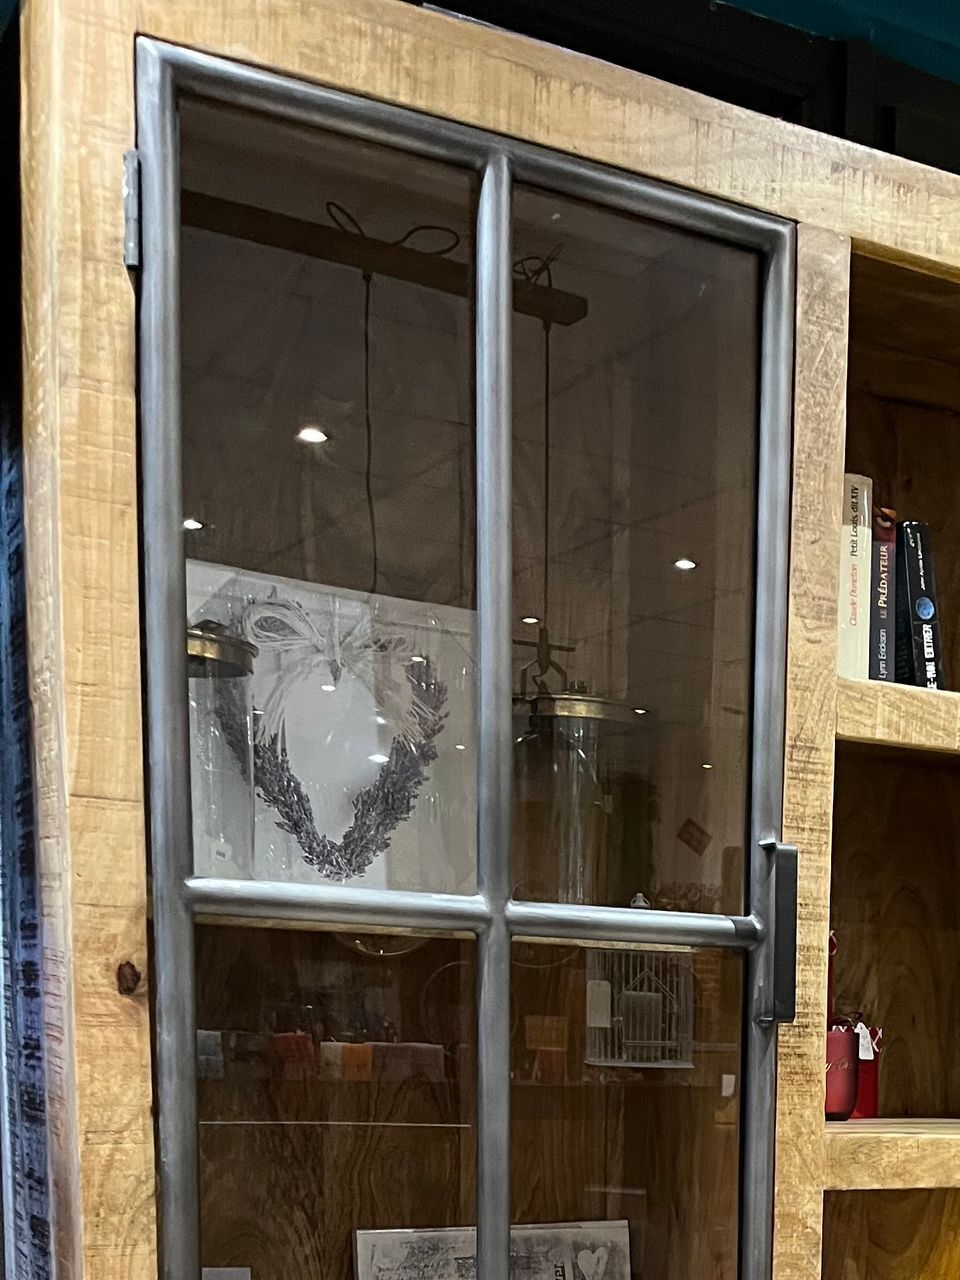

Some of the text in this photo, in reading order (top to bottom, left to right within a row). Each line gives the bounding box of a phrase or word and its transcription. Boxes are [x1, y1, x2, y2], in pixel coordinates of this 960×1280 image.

[877, 544, 889, 607] PRÉDATEUR
[922, 624, 935, 658] ENTRER
[878, 661, 888, 679] Lynn
